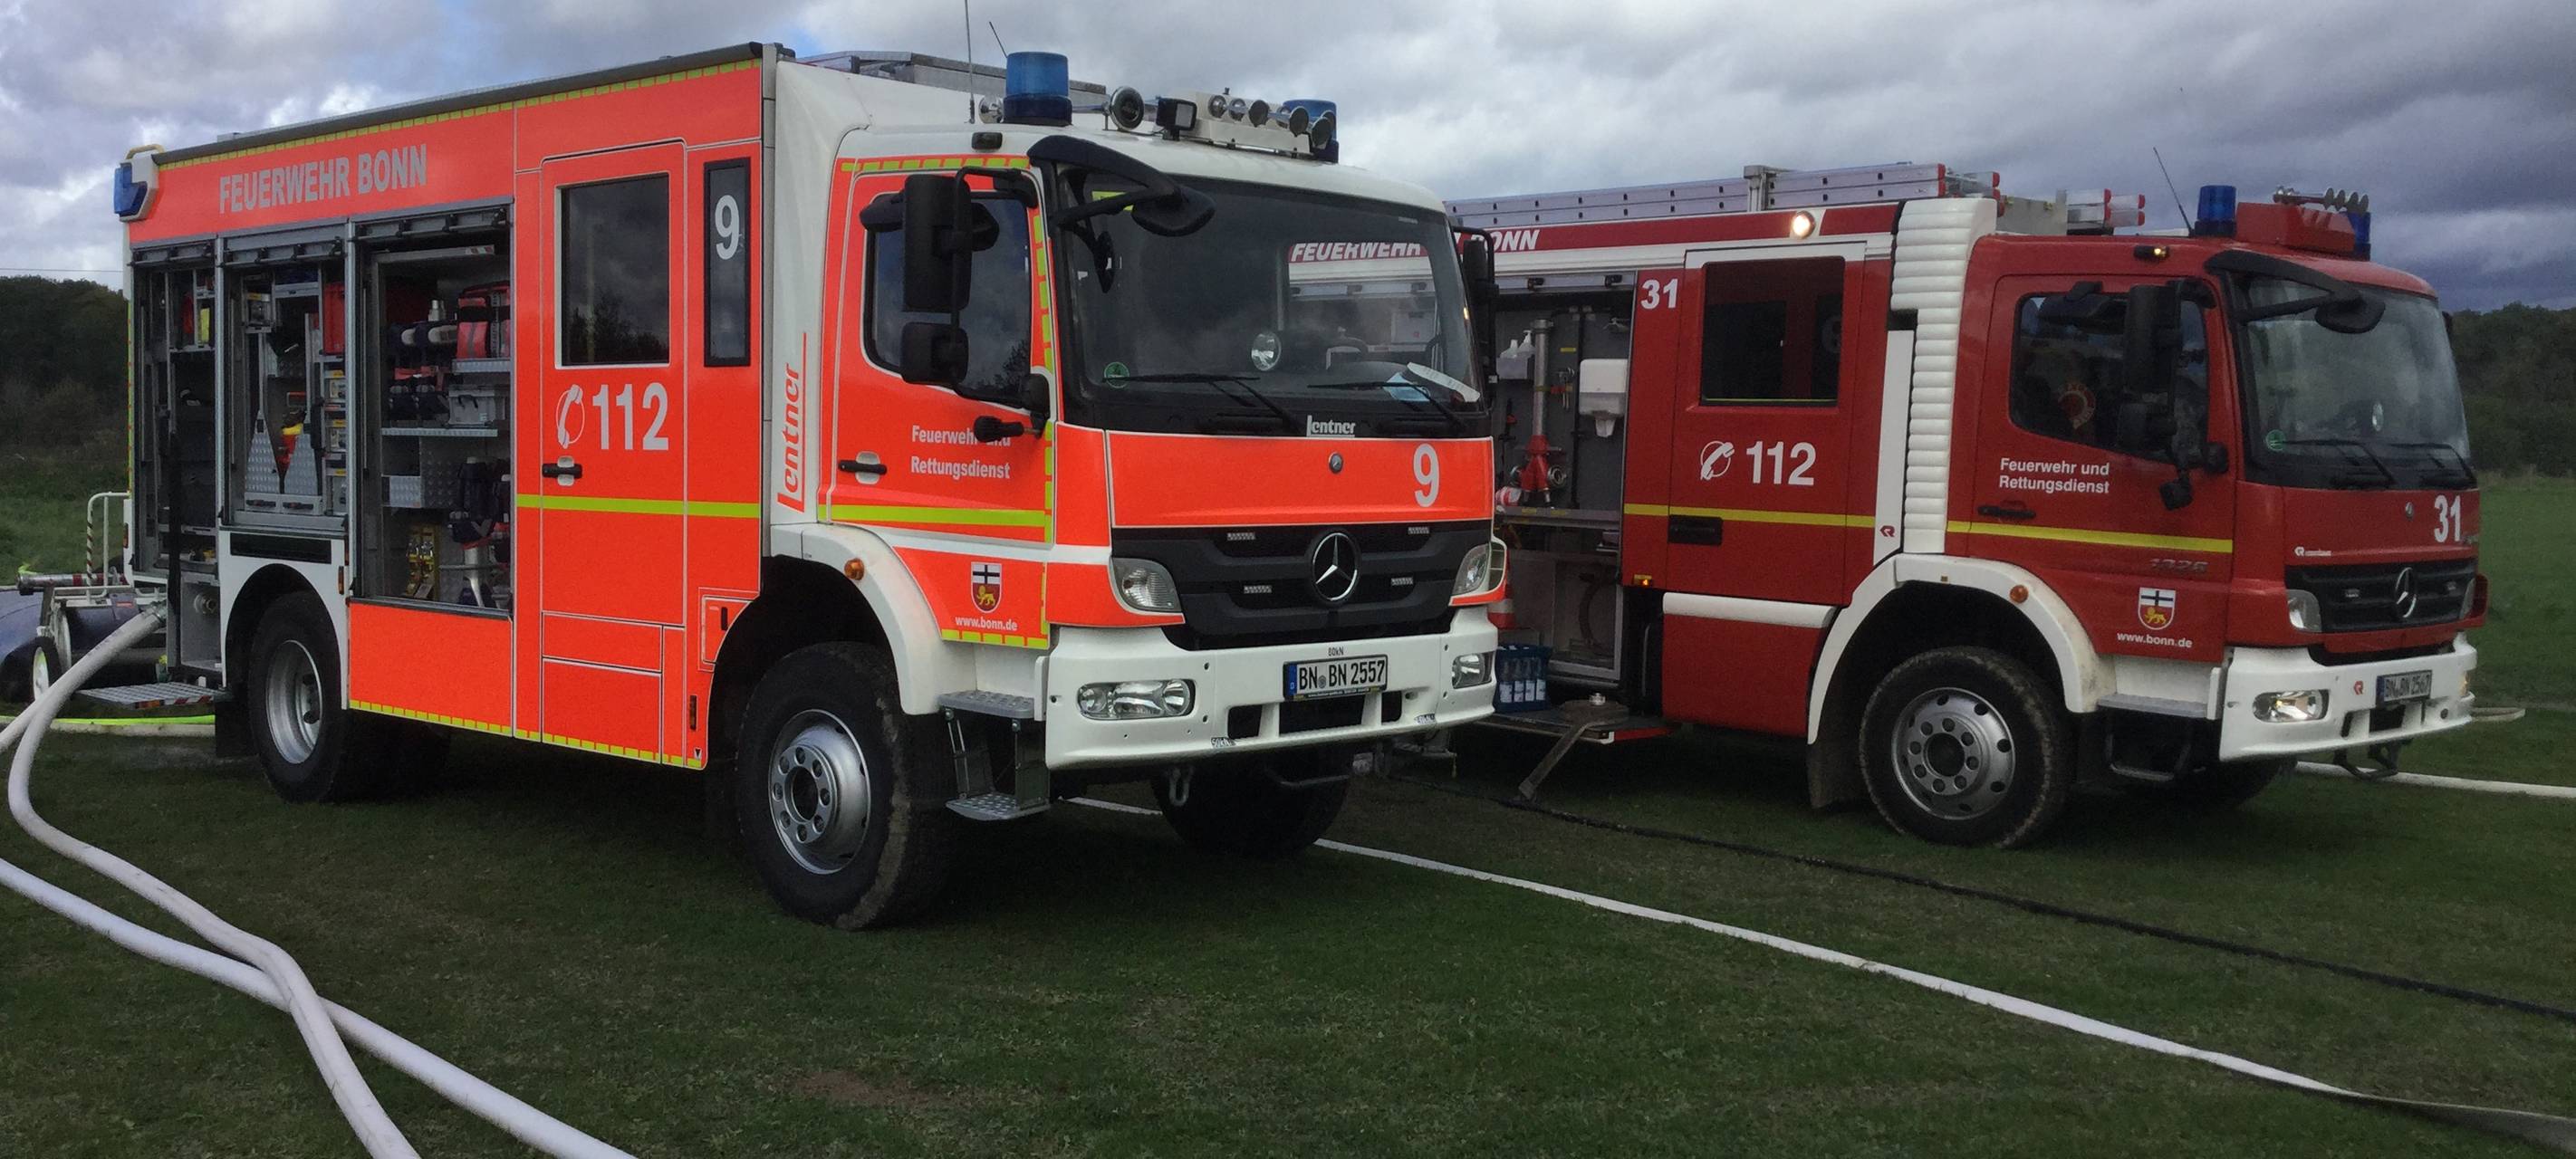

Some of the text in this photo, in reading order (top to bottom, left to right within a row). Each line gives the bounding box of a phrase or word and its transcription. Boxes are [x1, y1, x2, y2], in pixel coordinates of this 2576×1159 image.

[219, 143, 427, 215] FEUERWEHR BONN
[715, 195, 740, 260] 9
[1640, 279, 1678, 310] 31
[592, 382, 669, 450] 112
[910, 455, 1011, 480] Rettungsdienst
[1413, 443, 1440, 508] 9
[1746, 441, 1816, 486] 112
[2000, 457, 2110, 475] Feuerwehr und
[1998, 475, 2110, 493] Rettungsdienst
[2434, 494, 2461, 542] 31
[955, 617, 1018, 631] www.bonn.de
[2117, 633, 2193, 648] www.bonn.de
[1299, 666, 1317, 690] BN
[1329, 664, 1347, 687] BN
[1350, 660, 1385, 685] 2557
